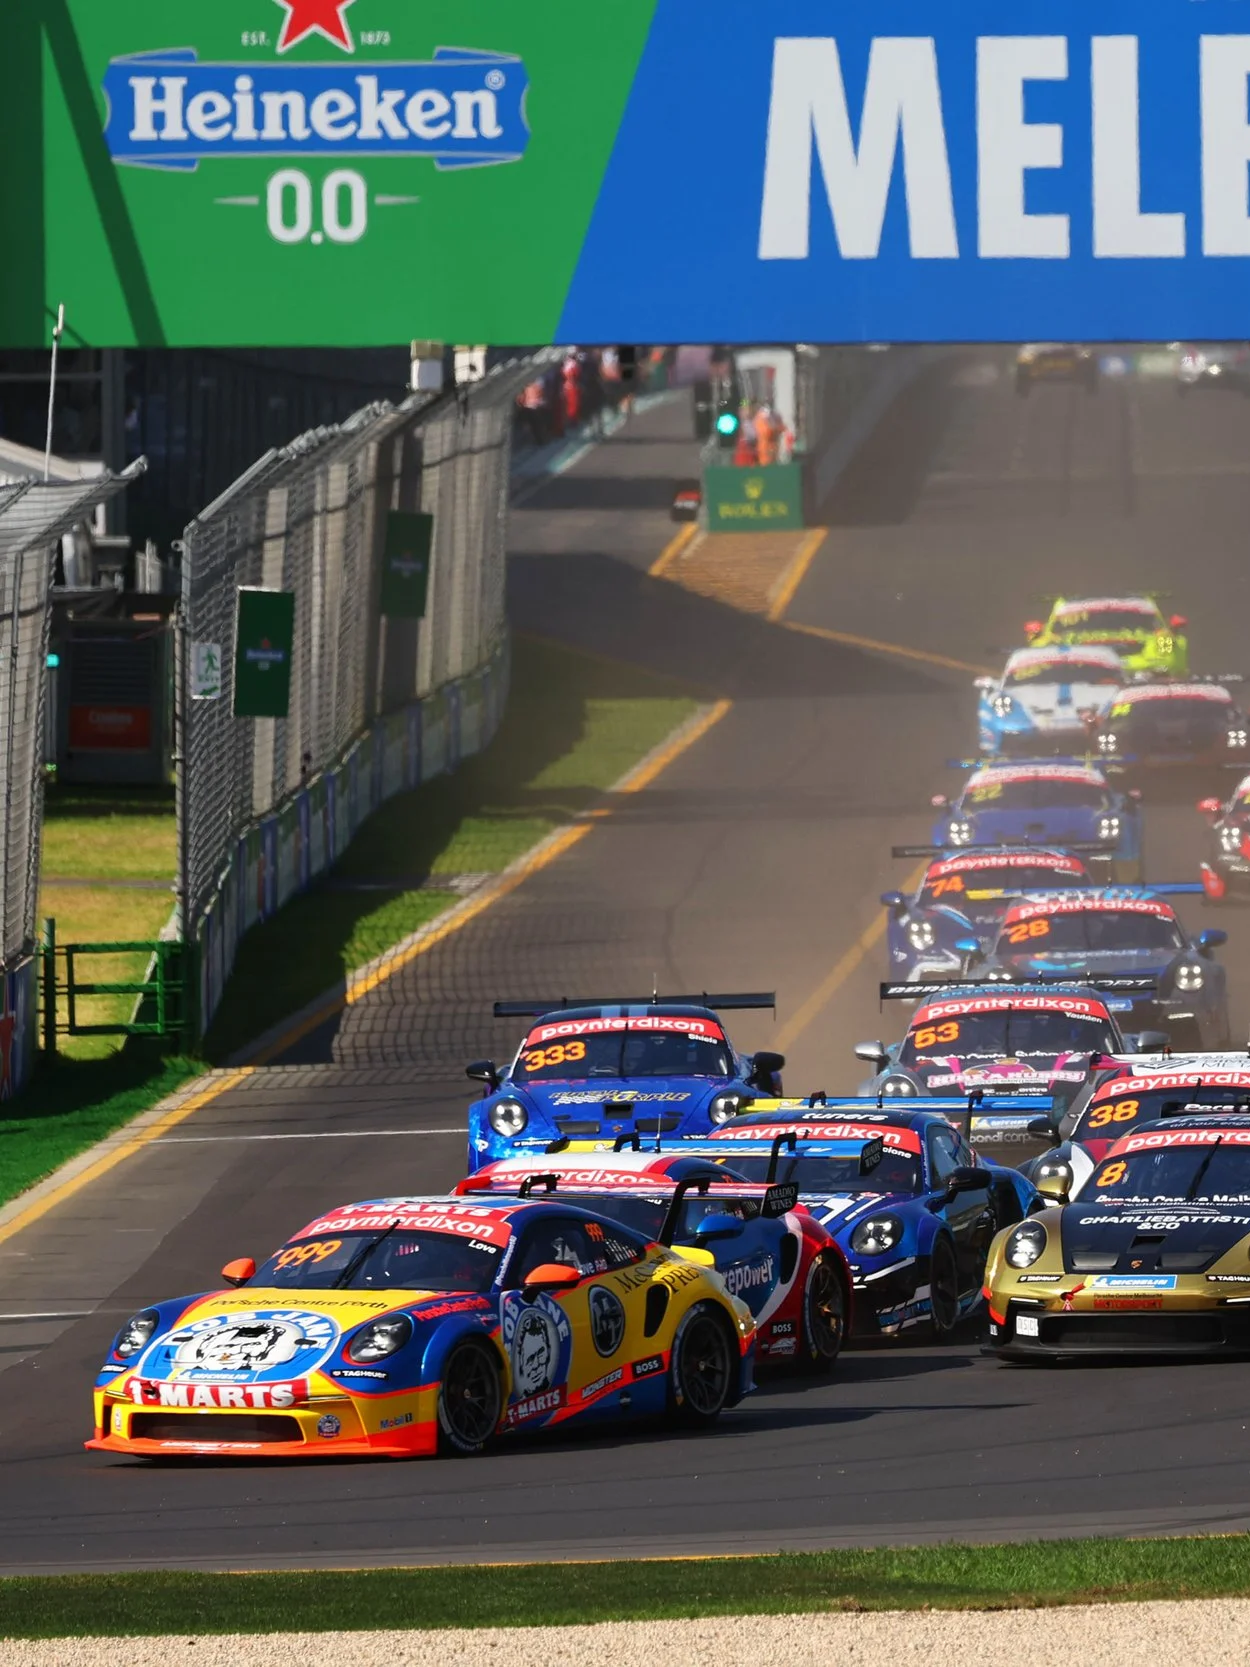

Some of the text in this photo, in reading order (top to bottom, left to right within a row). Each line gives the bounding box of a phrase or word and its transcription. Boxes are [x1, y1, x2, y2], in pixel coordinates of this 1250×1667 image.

[241, 31, 270, 45] EST.
[360, 30, 390, 45] 1873
[128, 74, 503, 140] Heineken
[266, 168, 368, 244] 0.0
[939, 855, 1071, 874] paynterdixon
[931, 875, 965, 898] 74
[1020, 899, 1161, 920] paynterdixon
[1009, 919, 1050, 944] 28
[927, 996, 1090, 1020] paynterdixon
[541, 1015, 705, 1040] paynterdixon
[914, 1020, 960, 1049] 53
[524, 1040, 587, 1073] 333
[802, 1113, 889, 1121] tuners
[1088, 1100, 1140, 1128] 38
[1096, 1161, 1128, 1187] 8
[341, 1203, 492, 1217] T-MARTS
[1079, 1214, 1250, 1226] CHARLIEBATTISTI
[311, 1213, 495, 1238] paynterdixon
[1136, 1222, 1181, 1230] &CO
[273, 1239, 343, 1271] 999
[212, 1299, 388, 1309] Porsche Centre Perth
[772, 1323, 792, 1333] BOSS
[635, 1358, 660, 1374] BOSS
[507, 1388, 561, 1423] T-MARTS
[381, 1416, 404, 1428] Mobil
